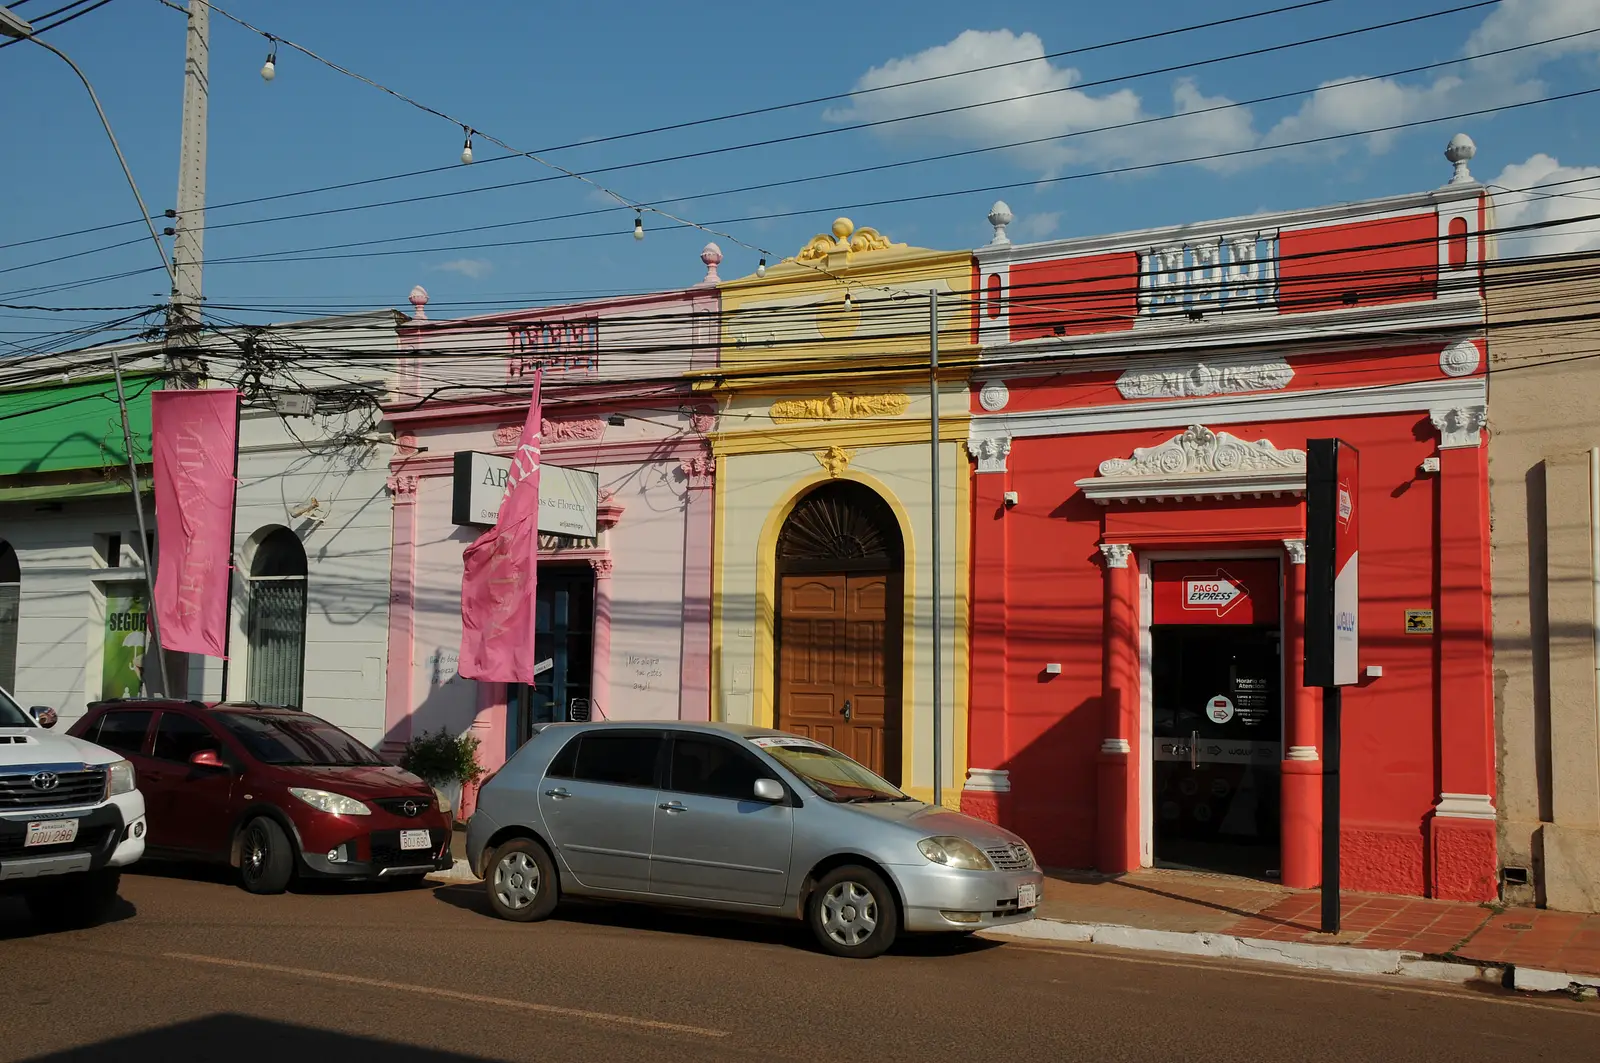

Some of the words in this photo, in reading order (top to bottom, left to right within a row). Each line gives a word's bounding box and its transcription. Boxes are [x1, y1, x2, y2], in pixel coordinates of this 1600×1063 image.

[1193, 584, 1220, 593] PAGO
[1190, 592, 1233, 601] EXPRESS
[30, 831, 51, 844] CDU
